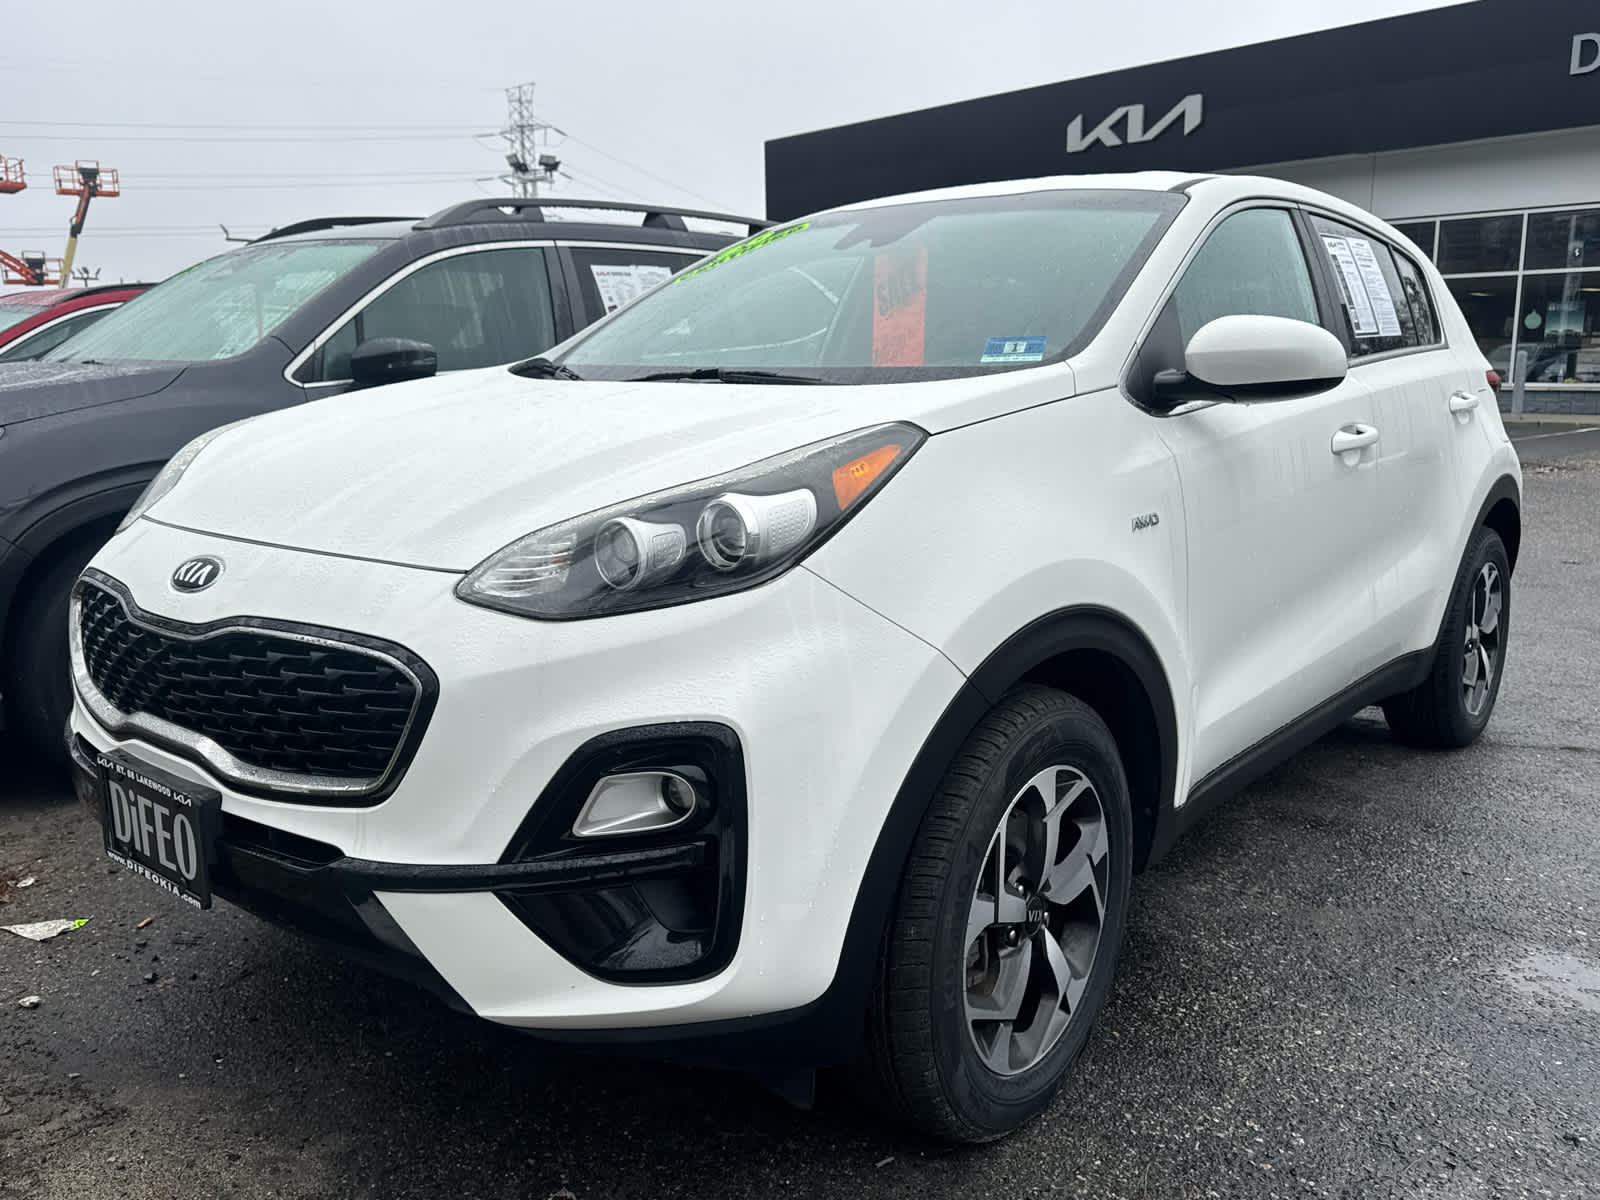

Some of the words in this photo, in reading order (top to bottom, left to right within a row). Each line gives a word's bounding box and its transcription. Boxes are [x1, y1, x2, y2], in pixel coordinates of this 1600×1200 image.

[1066, 93, 1202, 153] KIA
[1131, 513, 1160, 532] AWD
[174, 561, 213, 586] KIA
[135, 773, 171, 797] LAKEWOOD
[108, 779, 197, 881] DiFEO
